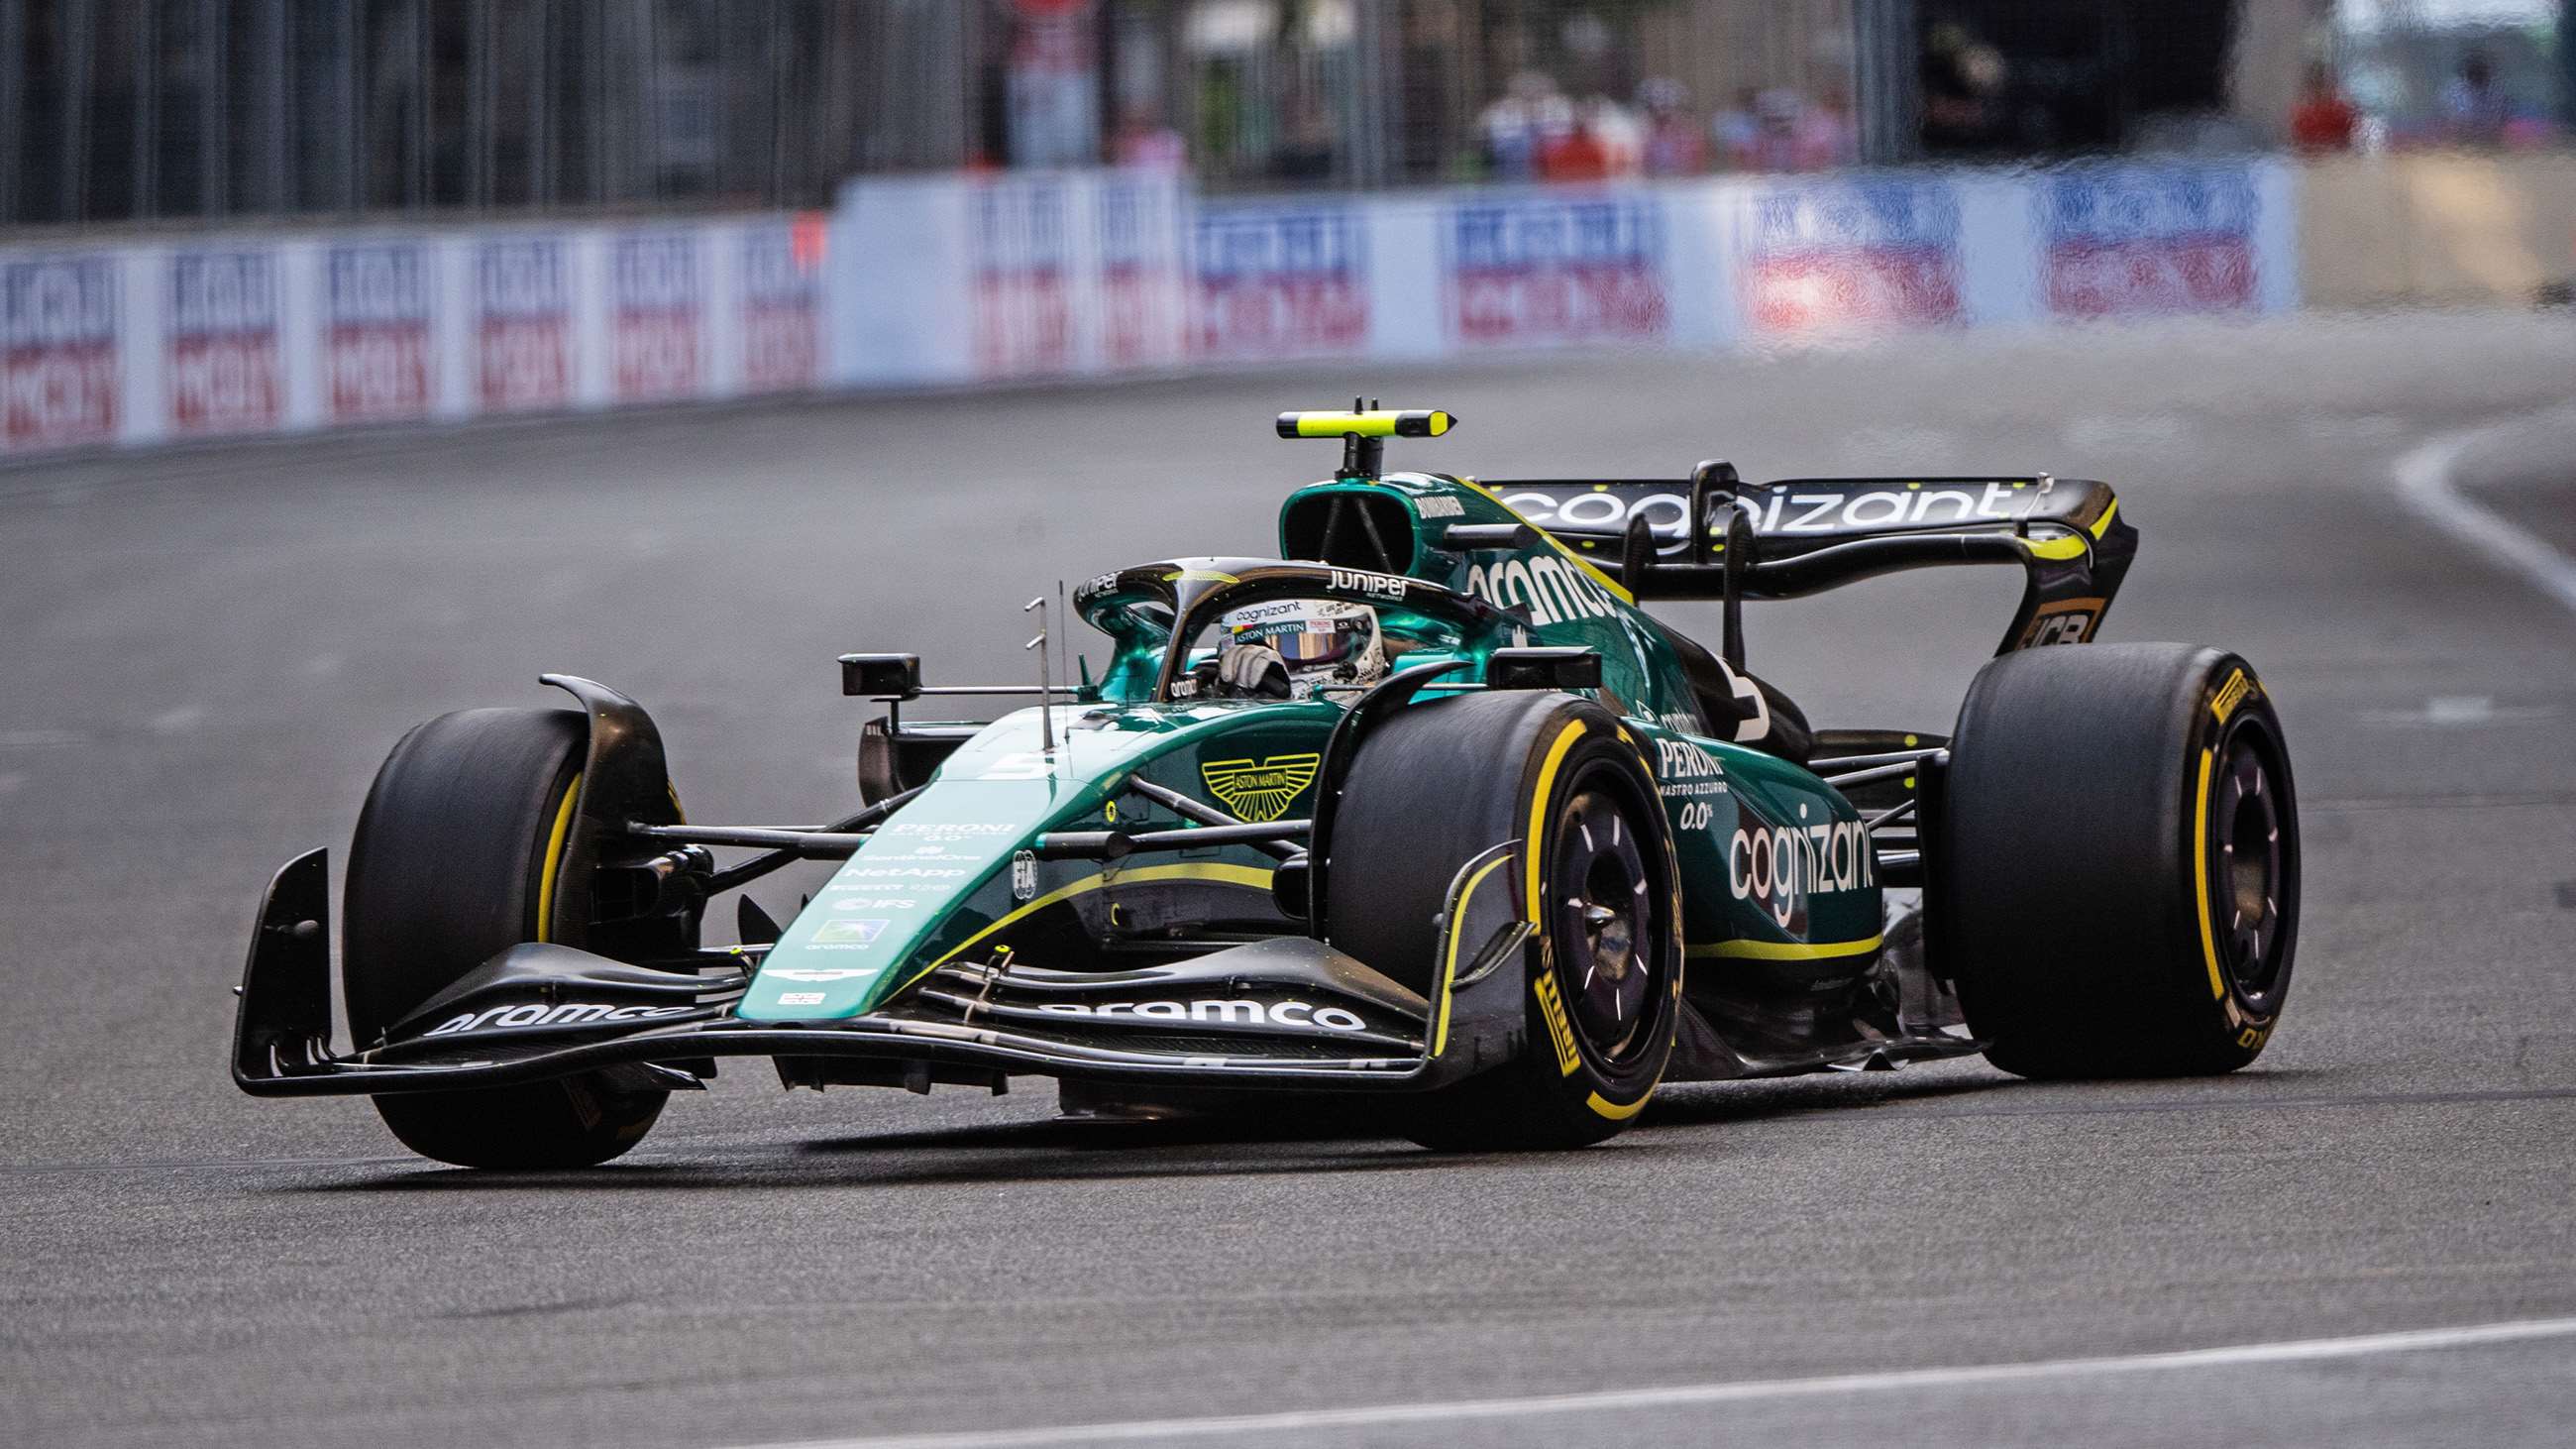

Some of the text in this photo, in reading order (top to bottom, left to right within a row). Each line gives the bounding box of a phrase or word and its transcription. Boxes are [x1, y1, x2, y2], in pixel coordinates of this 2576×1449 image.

[1265, 622, 1305, 635] MARTIN
[1656, 737, 1724, 778] PERONI
[1694, 781, 1728, 794] AZZURRO
[893, 824, 1016, 834] PERONI
[843, 867, 967, 877] NetApp
[423, 1003, 696, 1037] aramco
[1038, 999, 1366, 1031] aramco
